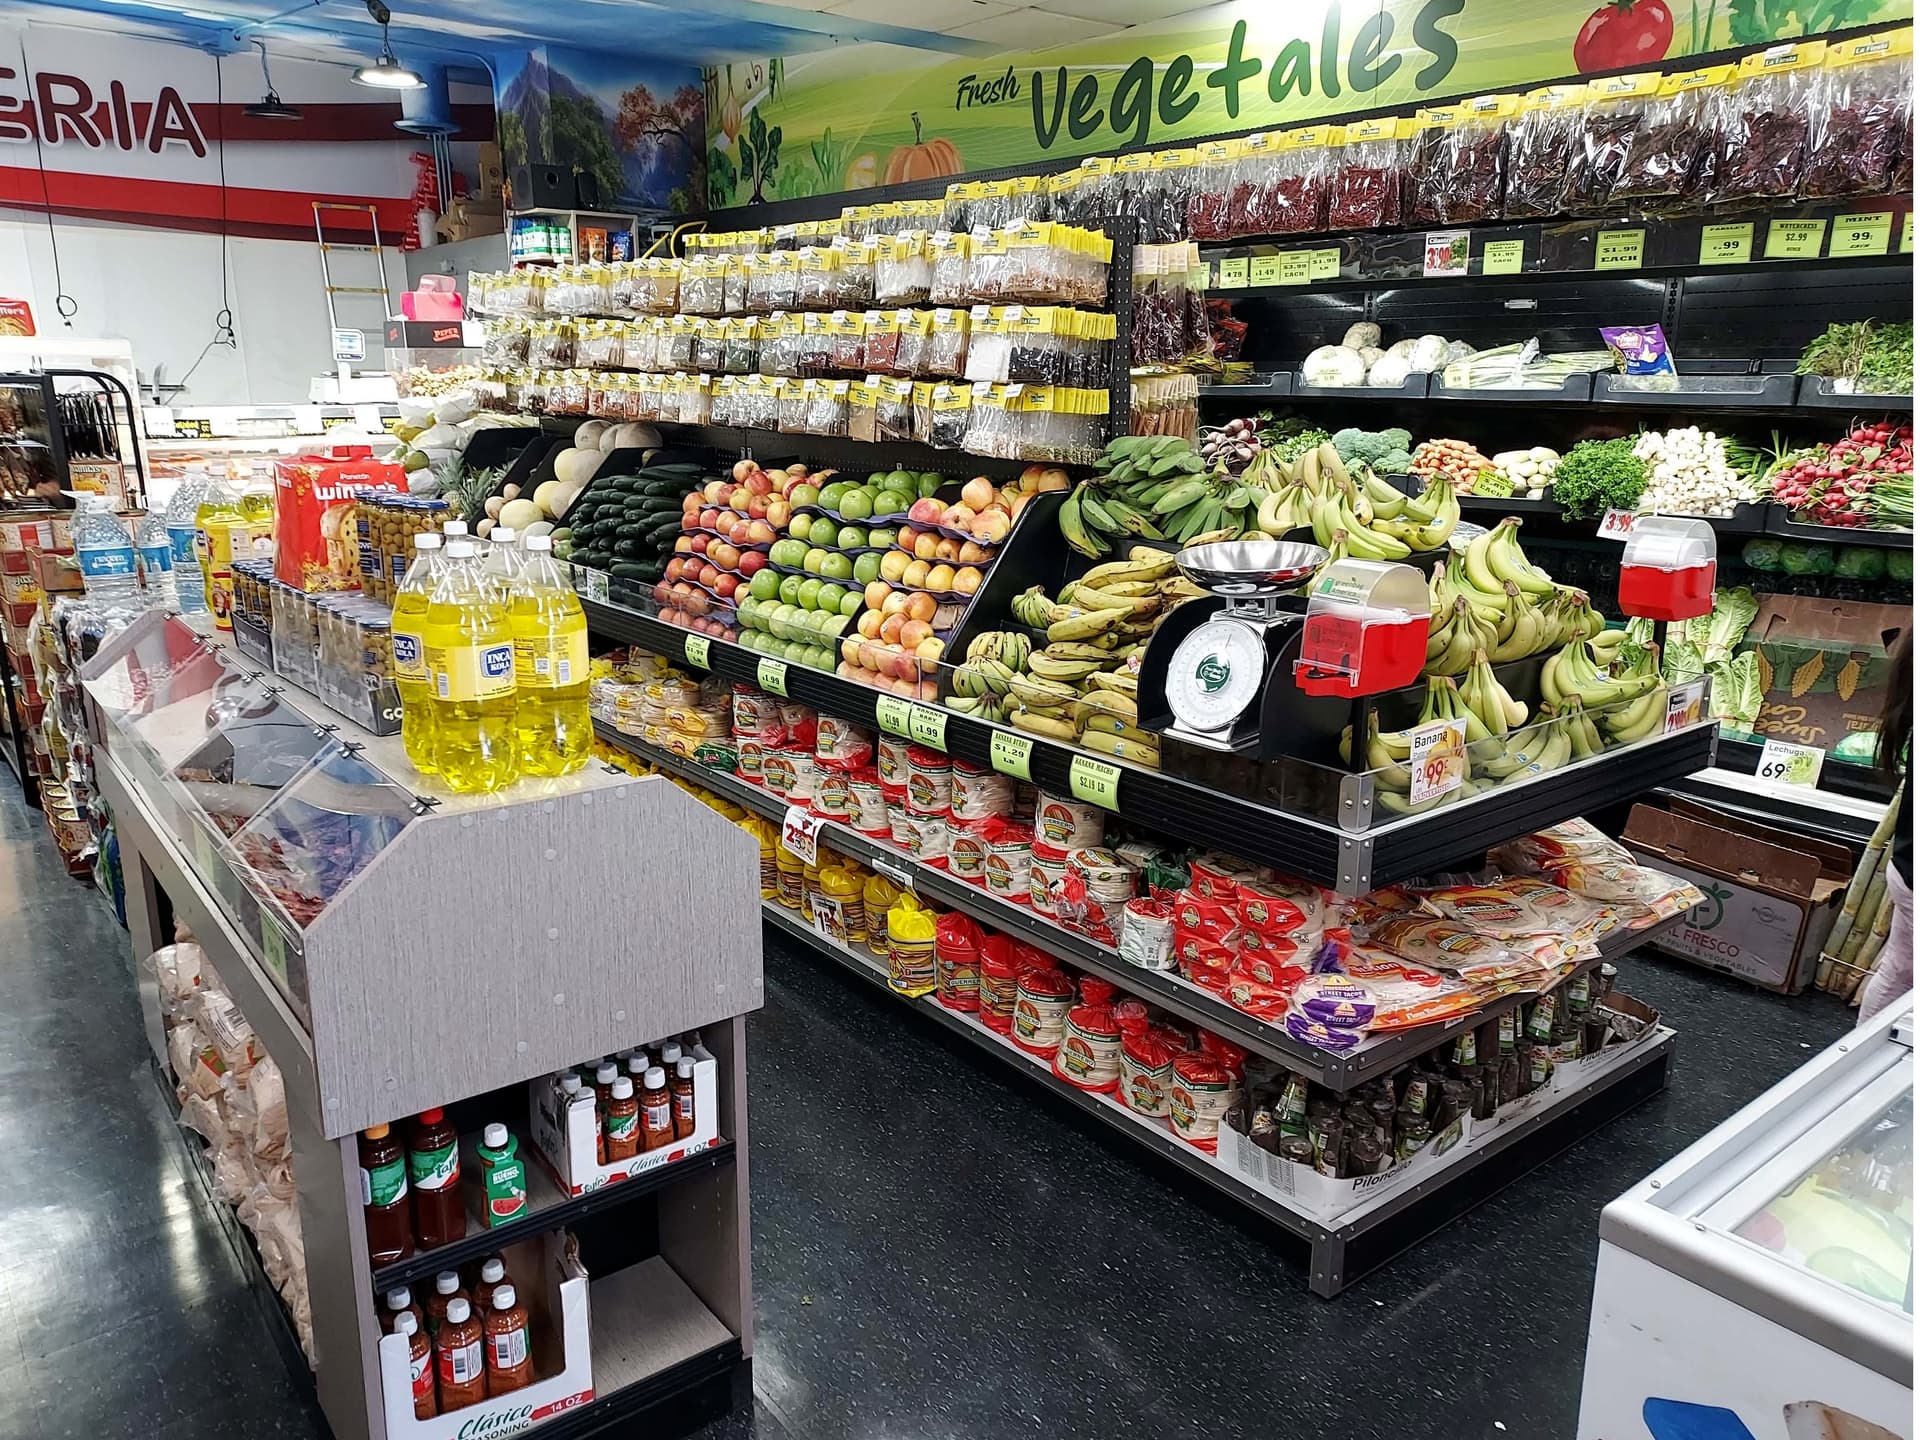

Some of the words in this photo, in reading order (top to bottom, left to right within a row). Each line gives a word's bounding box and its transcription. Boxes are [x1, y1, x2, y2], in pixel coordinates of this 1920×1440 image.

[1032, 0, 1464, 149] Vegetales
[956, 65, 1021, 111] Fresh
[1845, 215, 1883, 223] MINT
[1785, 232, 1808, 242] $2.99
[1602, 245, 1638, 253] $1.99
[1600, 255, 1638, 263] EACH
[486, 652, 510, 665] INCA
[1414, 730, 1448, 749] Banana
[994, 742, 1025, 758] $1.29
[1768, 744, 1805, 758] Lechuga
[1003, 757, 1015, 765] LB
[1683, 928, 1740, 958] FRESCO
[1703, 951, 1758, 976] VEGETABLES
[693, 1141, 708, 1153] OZ
[629, 1153, 668, 1174] Clásico
[550, 1401, 563, 1413] 14
[564, 1393, 584, 1409] OZ
[457, 1403, 534, 1440] Clásico
